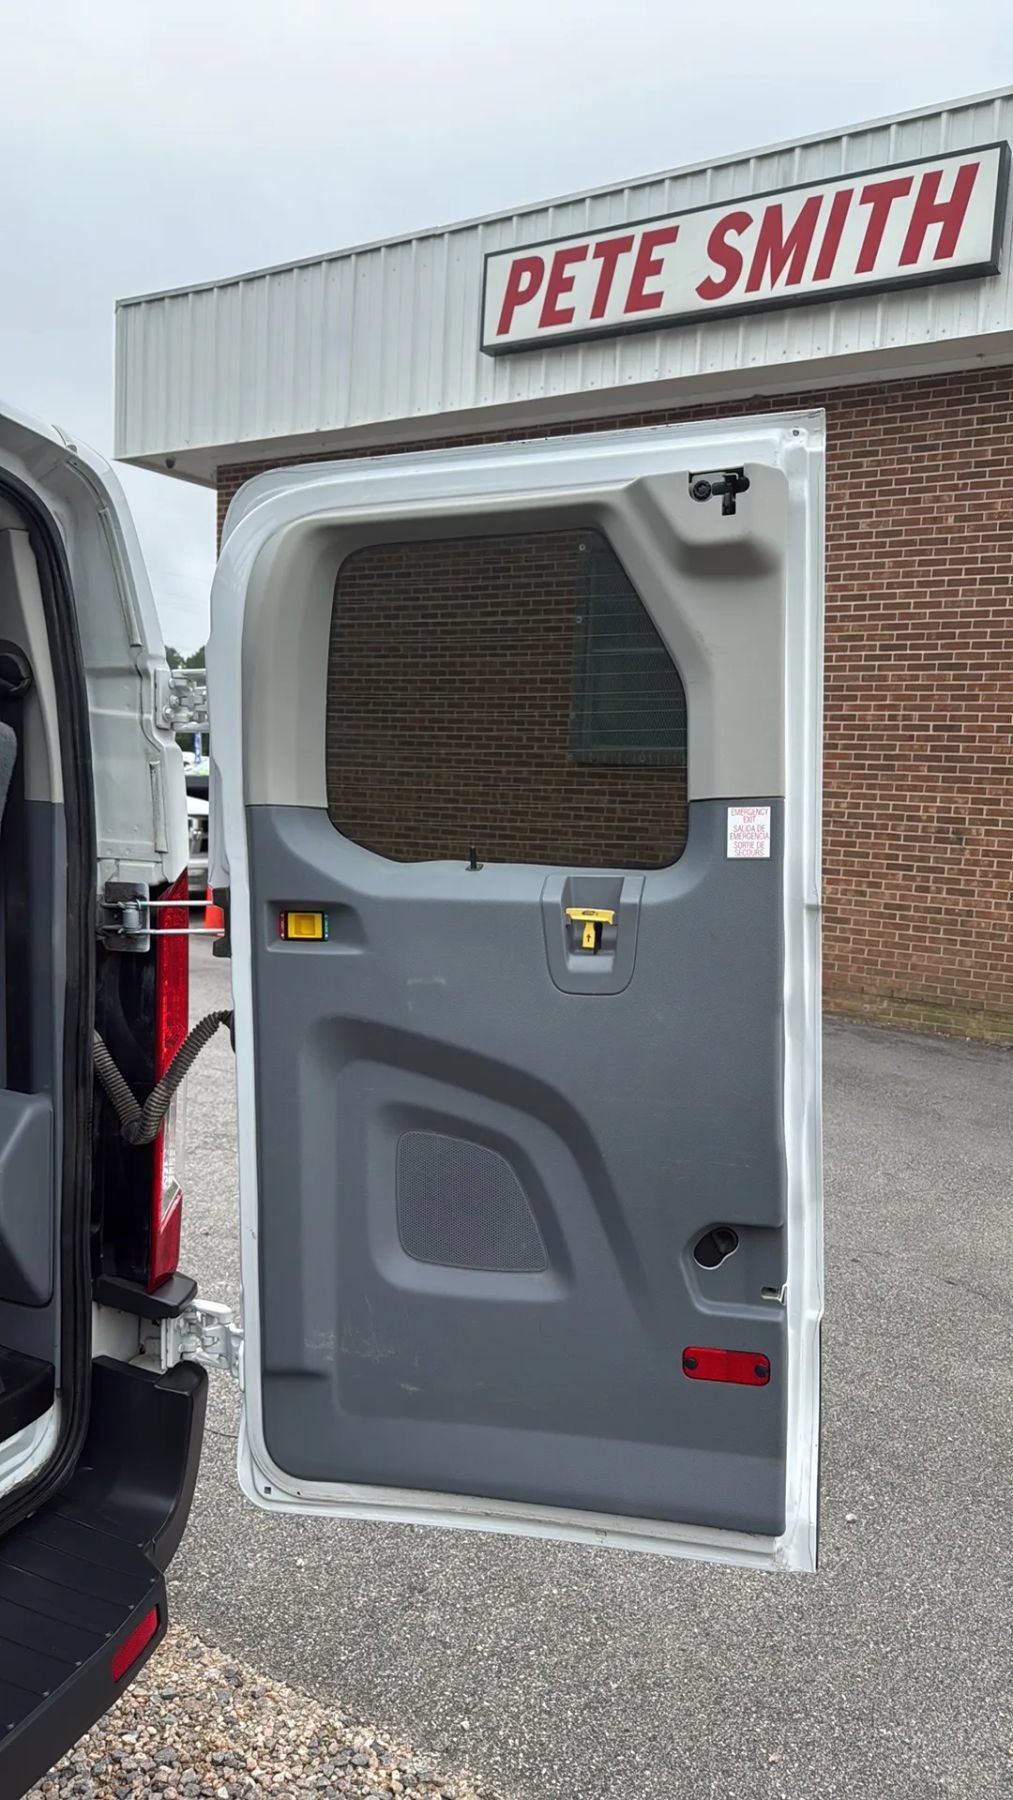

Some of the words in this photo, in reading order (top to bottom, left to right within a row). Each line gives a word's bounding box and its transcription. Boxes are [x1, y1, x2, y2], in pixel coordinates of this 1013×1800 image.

[496, 225, 679, 336] PETE
[695, 161, 981, 300] SMITH
[731, 808, 768, 816] EMERGENCY
[733, 824, 755, 832] SALIDA
[757, 824, 766, 832] DE
[730, 832, 768, 840] EMERGENCIA
[734, 841, 754, 849] SORTIE
[757, 841, 765, 849] DE
